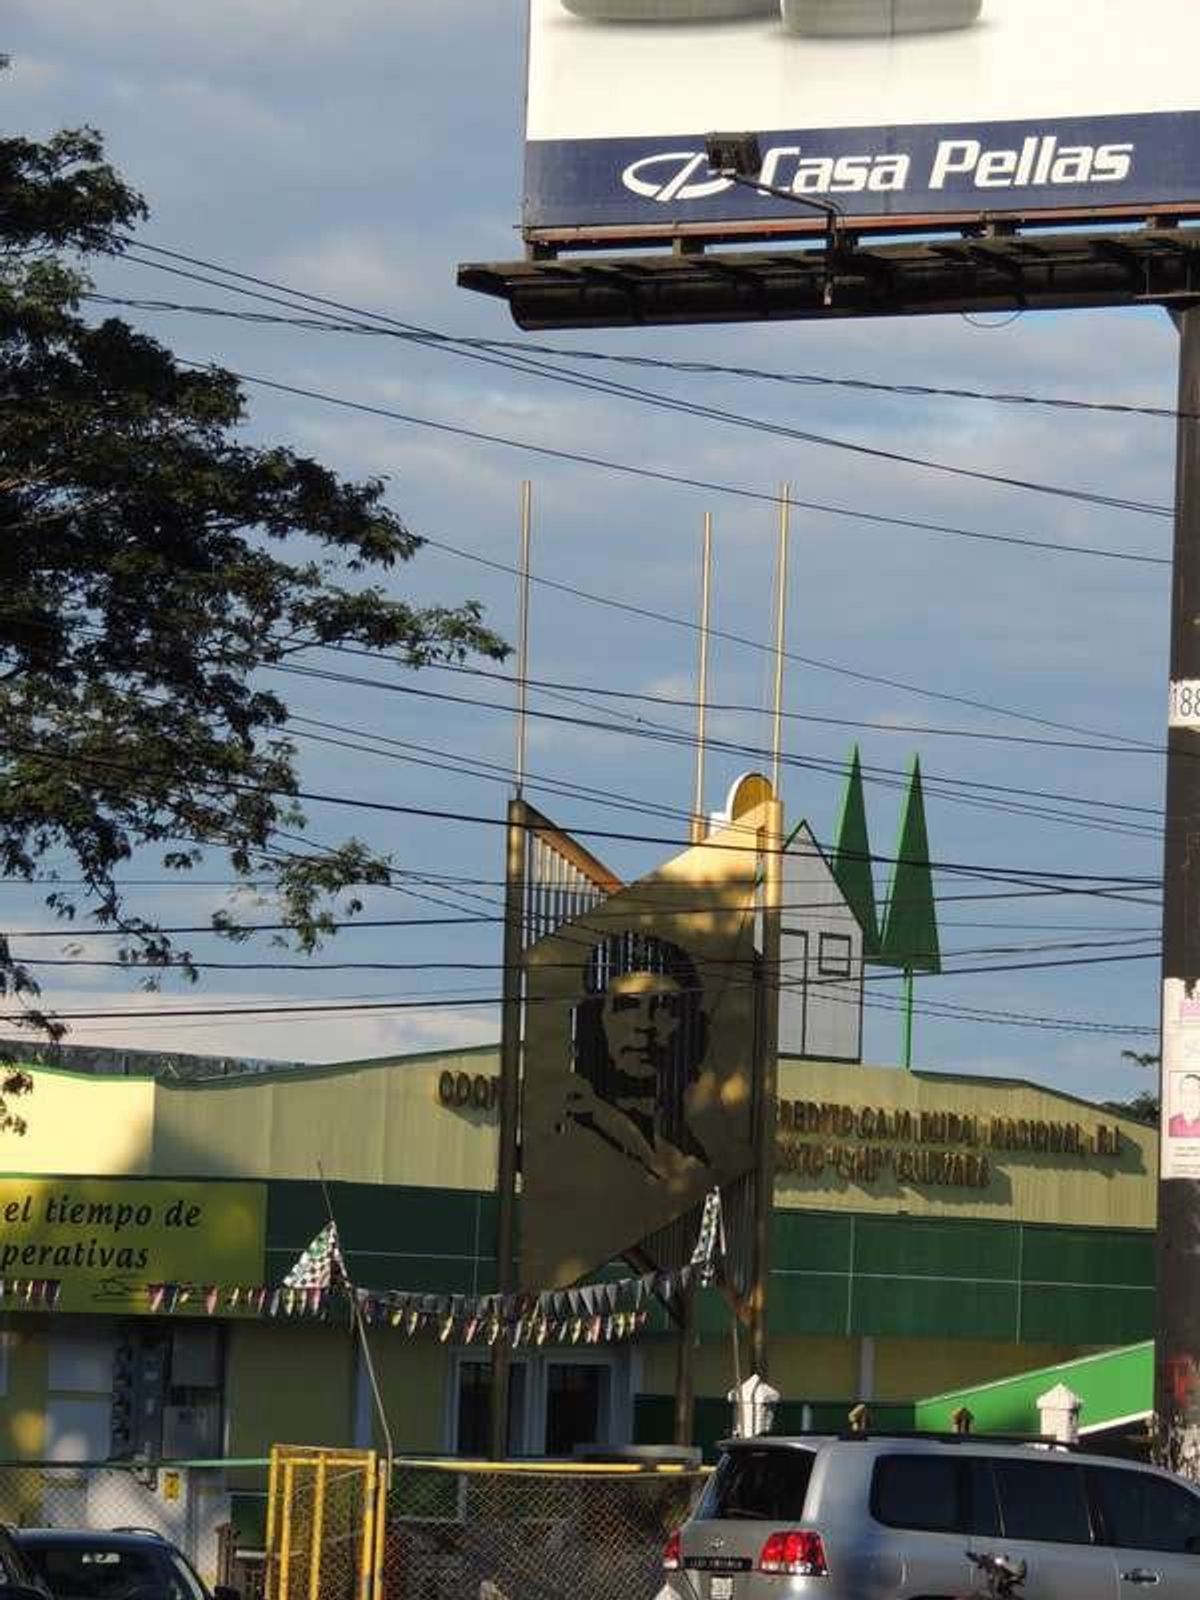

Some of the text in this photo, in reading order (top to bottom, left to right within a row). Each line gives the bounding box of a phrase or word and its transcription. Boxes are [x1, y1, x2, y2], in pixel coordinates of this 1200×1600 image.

[757, 135, 1134, 196] Casa Pellas
[4, 1195, 202, 1232] el tiempo de
